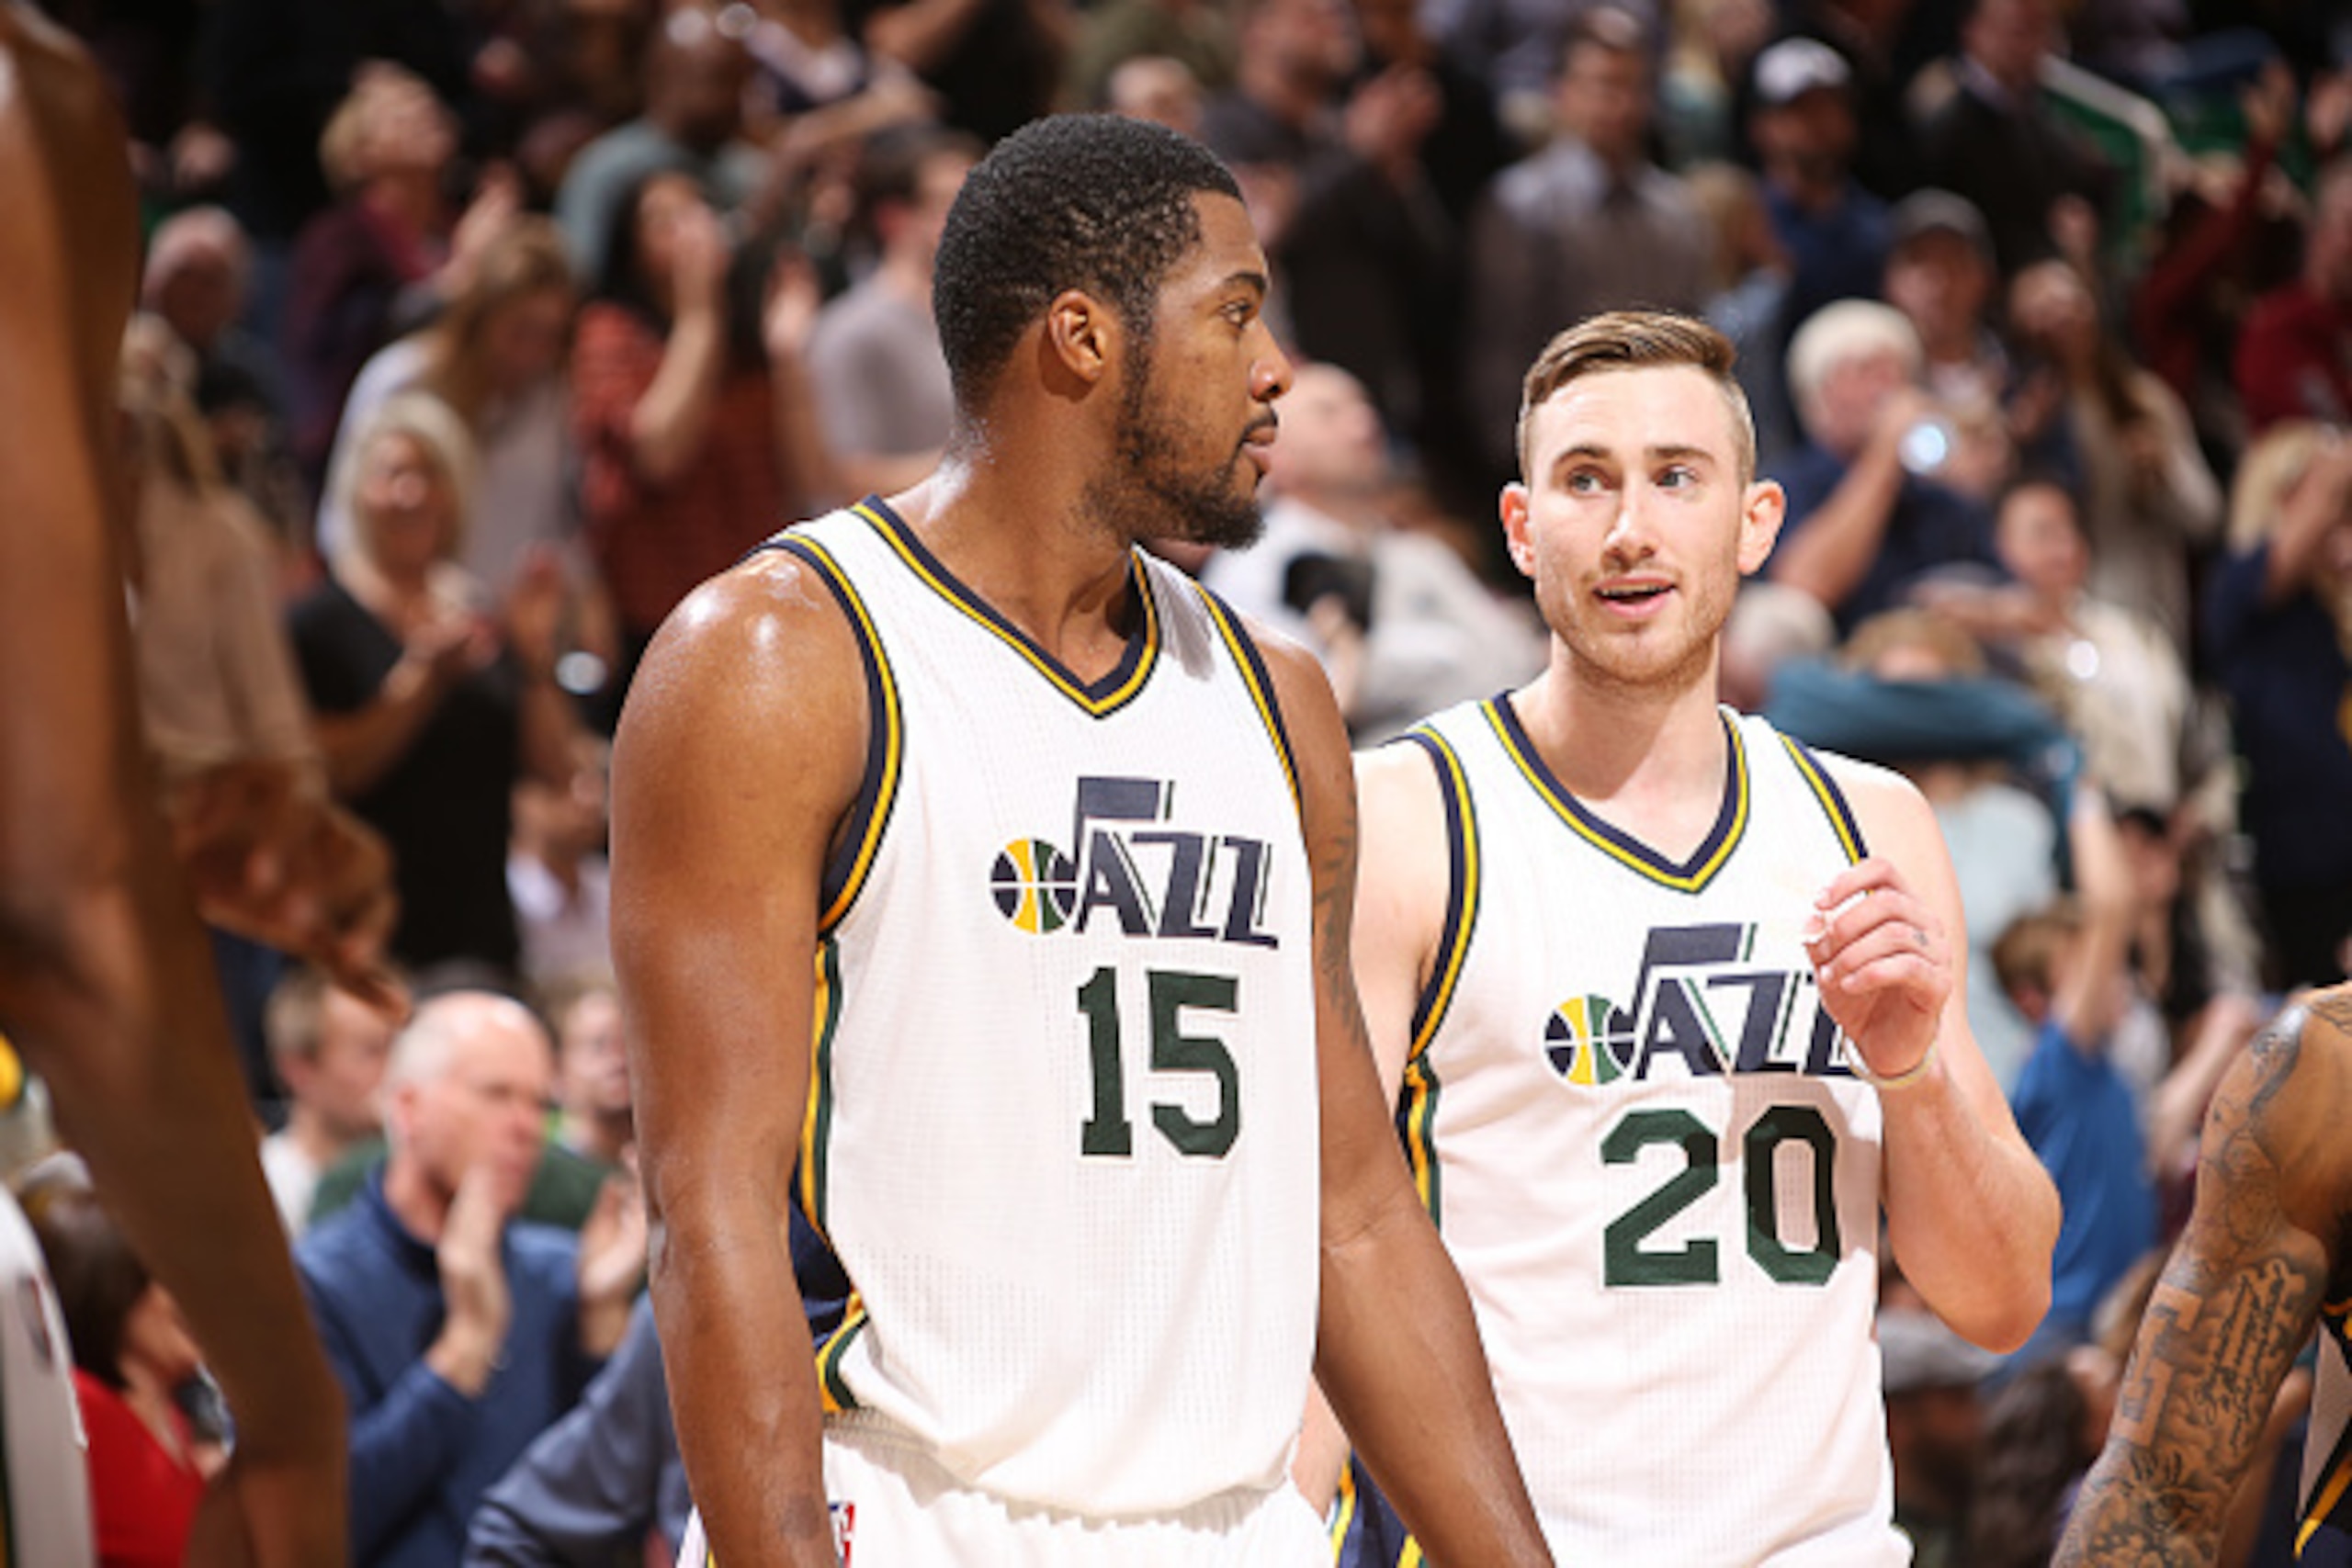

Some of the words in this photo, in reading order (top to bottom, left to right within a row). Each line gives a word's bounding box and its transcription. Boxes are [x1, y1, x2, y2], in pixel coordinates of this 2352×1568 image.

[990, 776, 1279, 950] JAZZ
[1077, 966, 1240, 1159] 15
[1600, 1105, 1841, 1287] 20
